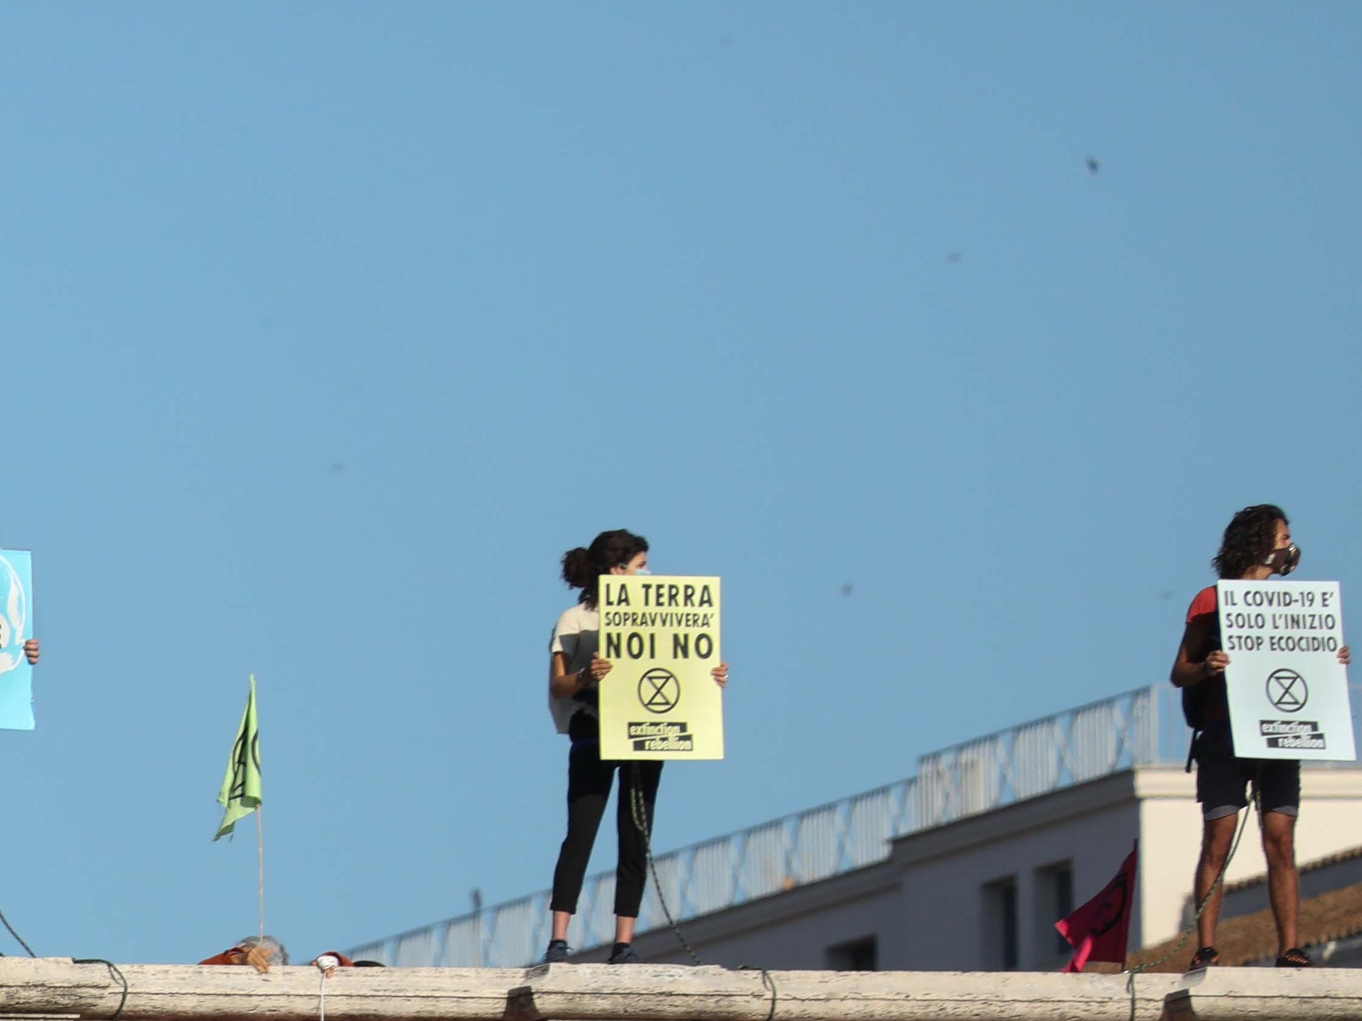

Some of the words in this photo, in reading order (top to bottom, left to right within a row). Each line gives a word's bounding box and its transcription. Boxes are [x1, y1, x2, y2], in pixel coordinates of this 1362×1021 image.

[605, 583, 631, 606] LA
[642, 584, 713, 607] TERRA
[1224, 590, 1237, 606] IL
[1244, 590, 1315, 607] COVID-19
[605, 612, 714, 627] SOPRAVVIVERA'
[1226, 613, 1265, 629] SOLO
[1272, 614, 1335, 630] L'INIZIO
[605, 632, 656, 659] NOI
[672, 633, 713, 659] NO
[1227, 635, 1264, 650] STOP
[1270, 636, 1337, 652] ECOCIDIO
[630, 722, 680, 735] extinction
[1262, 721, 1312, 733] extinction
[645, 735, 692, 750] rebellion
[1278, 735, 1324, 748] rebellion
